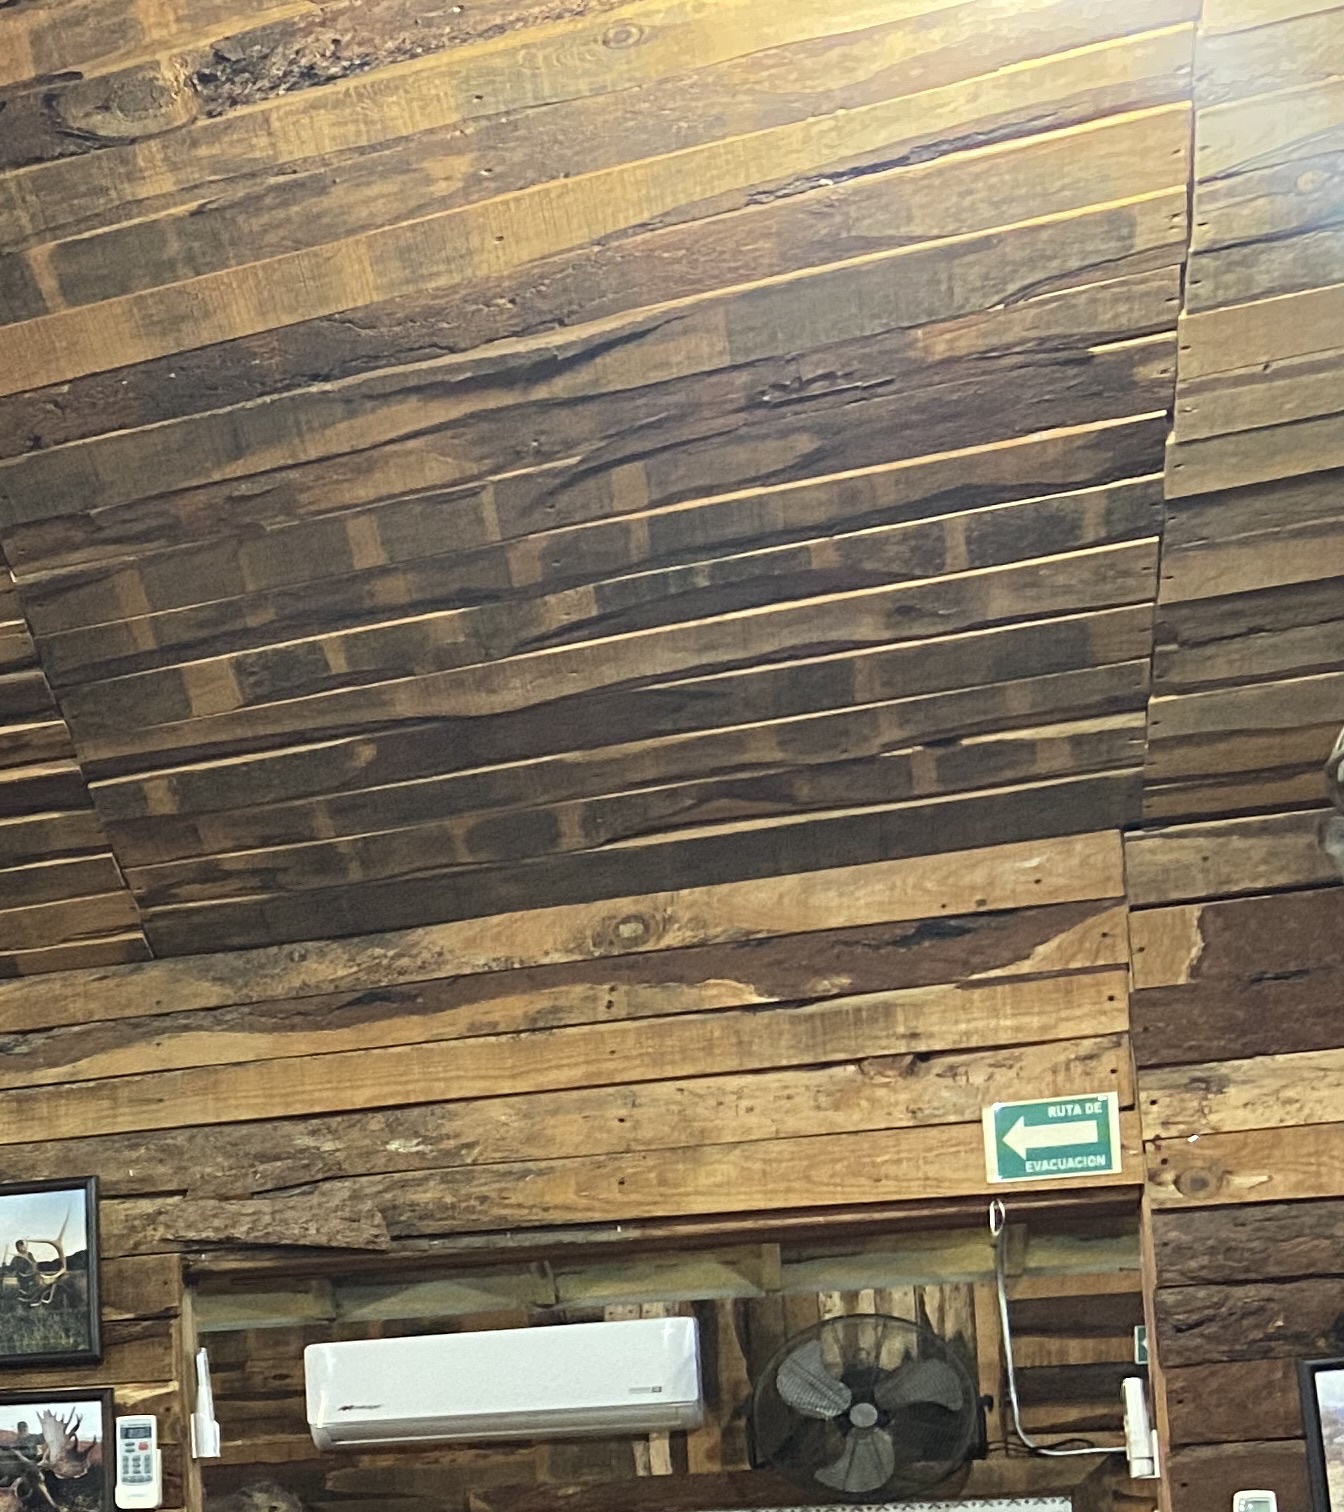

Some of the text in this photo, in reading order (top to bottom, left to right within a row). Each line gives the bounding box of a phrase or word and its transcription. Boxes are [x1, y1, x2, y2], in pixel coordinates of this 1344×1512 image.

[1047, 1101, 1103, 1118] RUTA DE
[1025, 1154, 1106, 1173] EVACUACION
